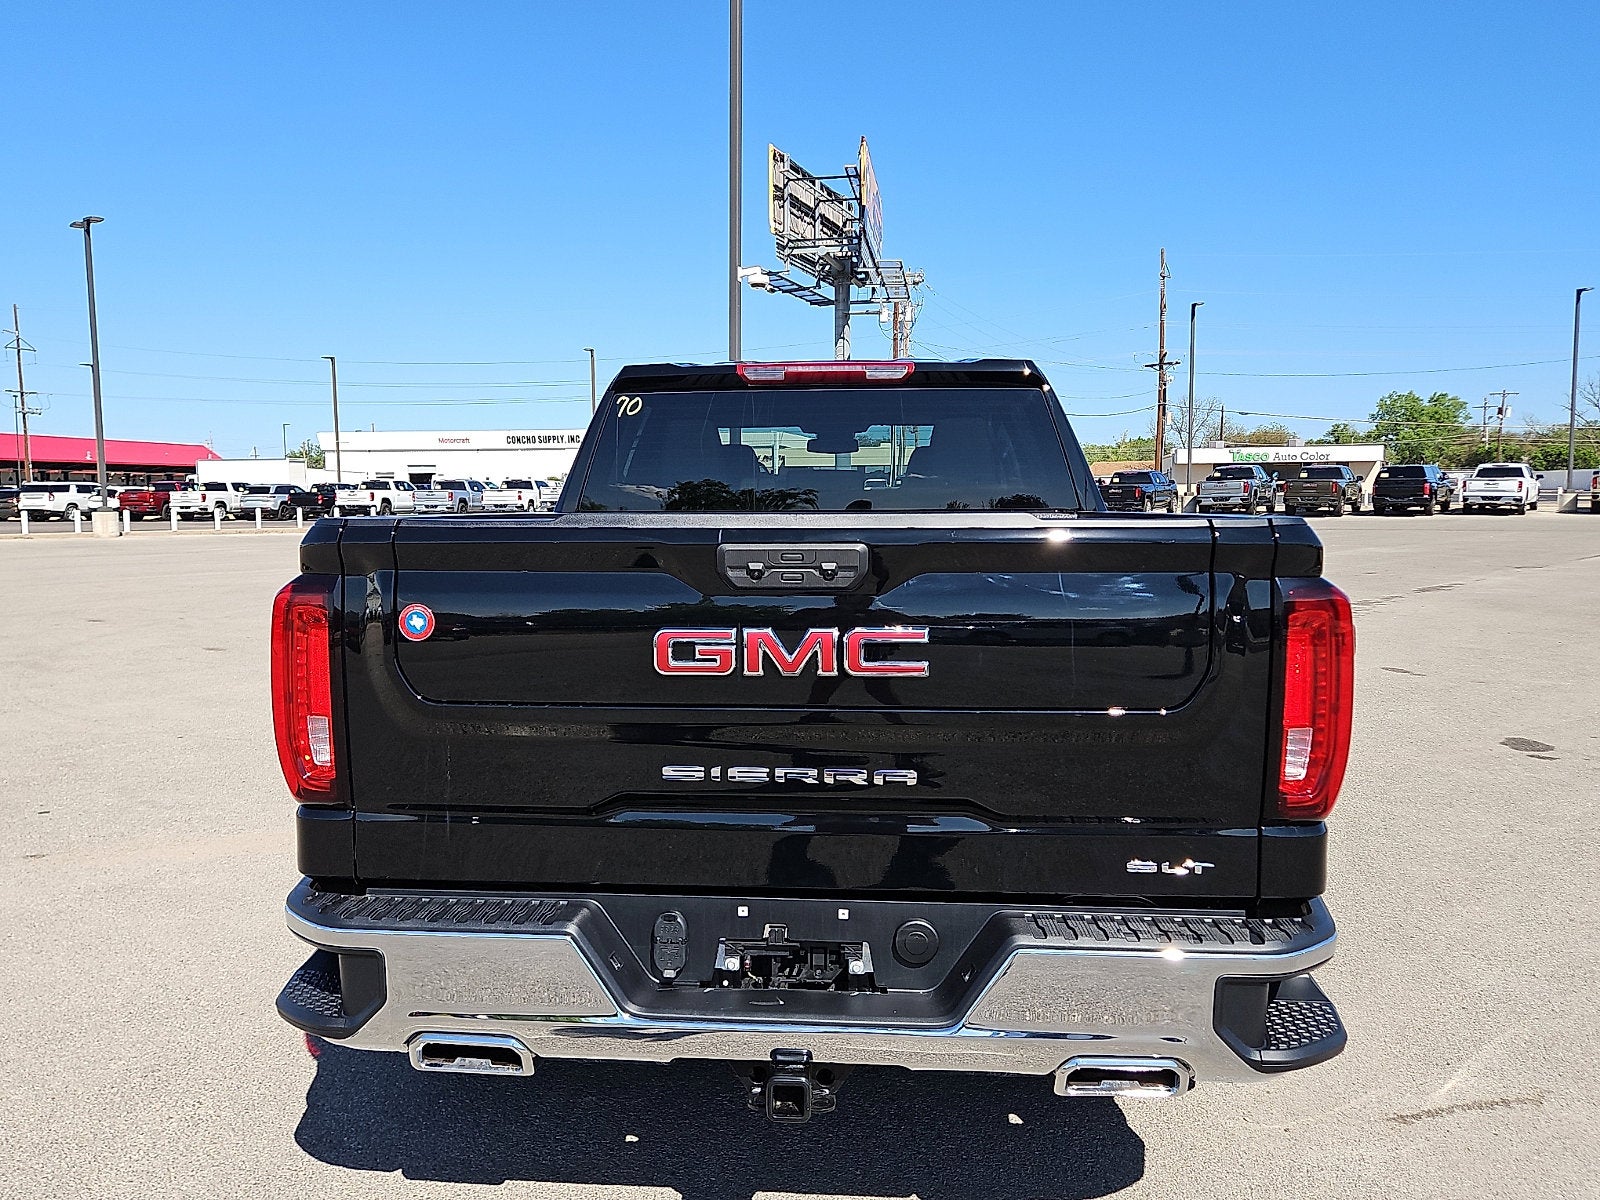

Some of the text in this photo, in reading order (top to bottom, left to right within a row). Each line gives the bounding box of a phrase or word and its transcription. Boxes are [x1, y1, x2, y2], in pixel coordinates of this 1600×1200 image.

[616, 395, 643, 418] 70
[506, 435, 537, 445] CONCHO
[1273, 452, 1298, 461] Auto
[1300, 451, 1331, 461] Color
[653, 626, 930, 677] GMC
[661, 765, 918, 786] SIERRA
[1126, 858, 1216, 876] SLT
